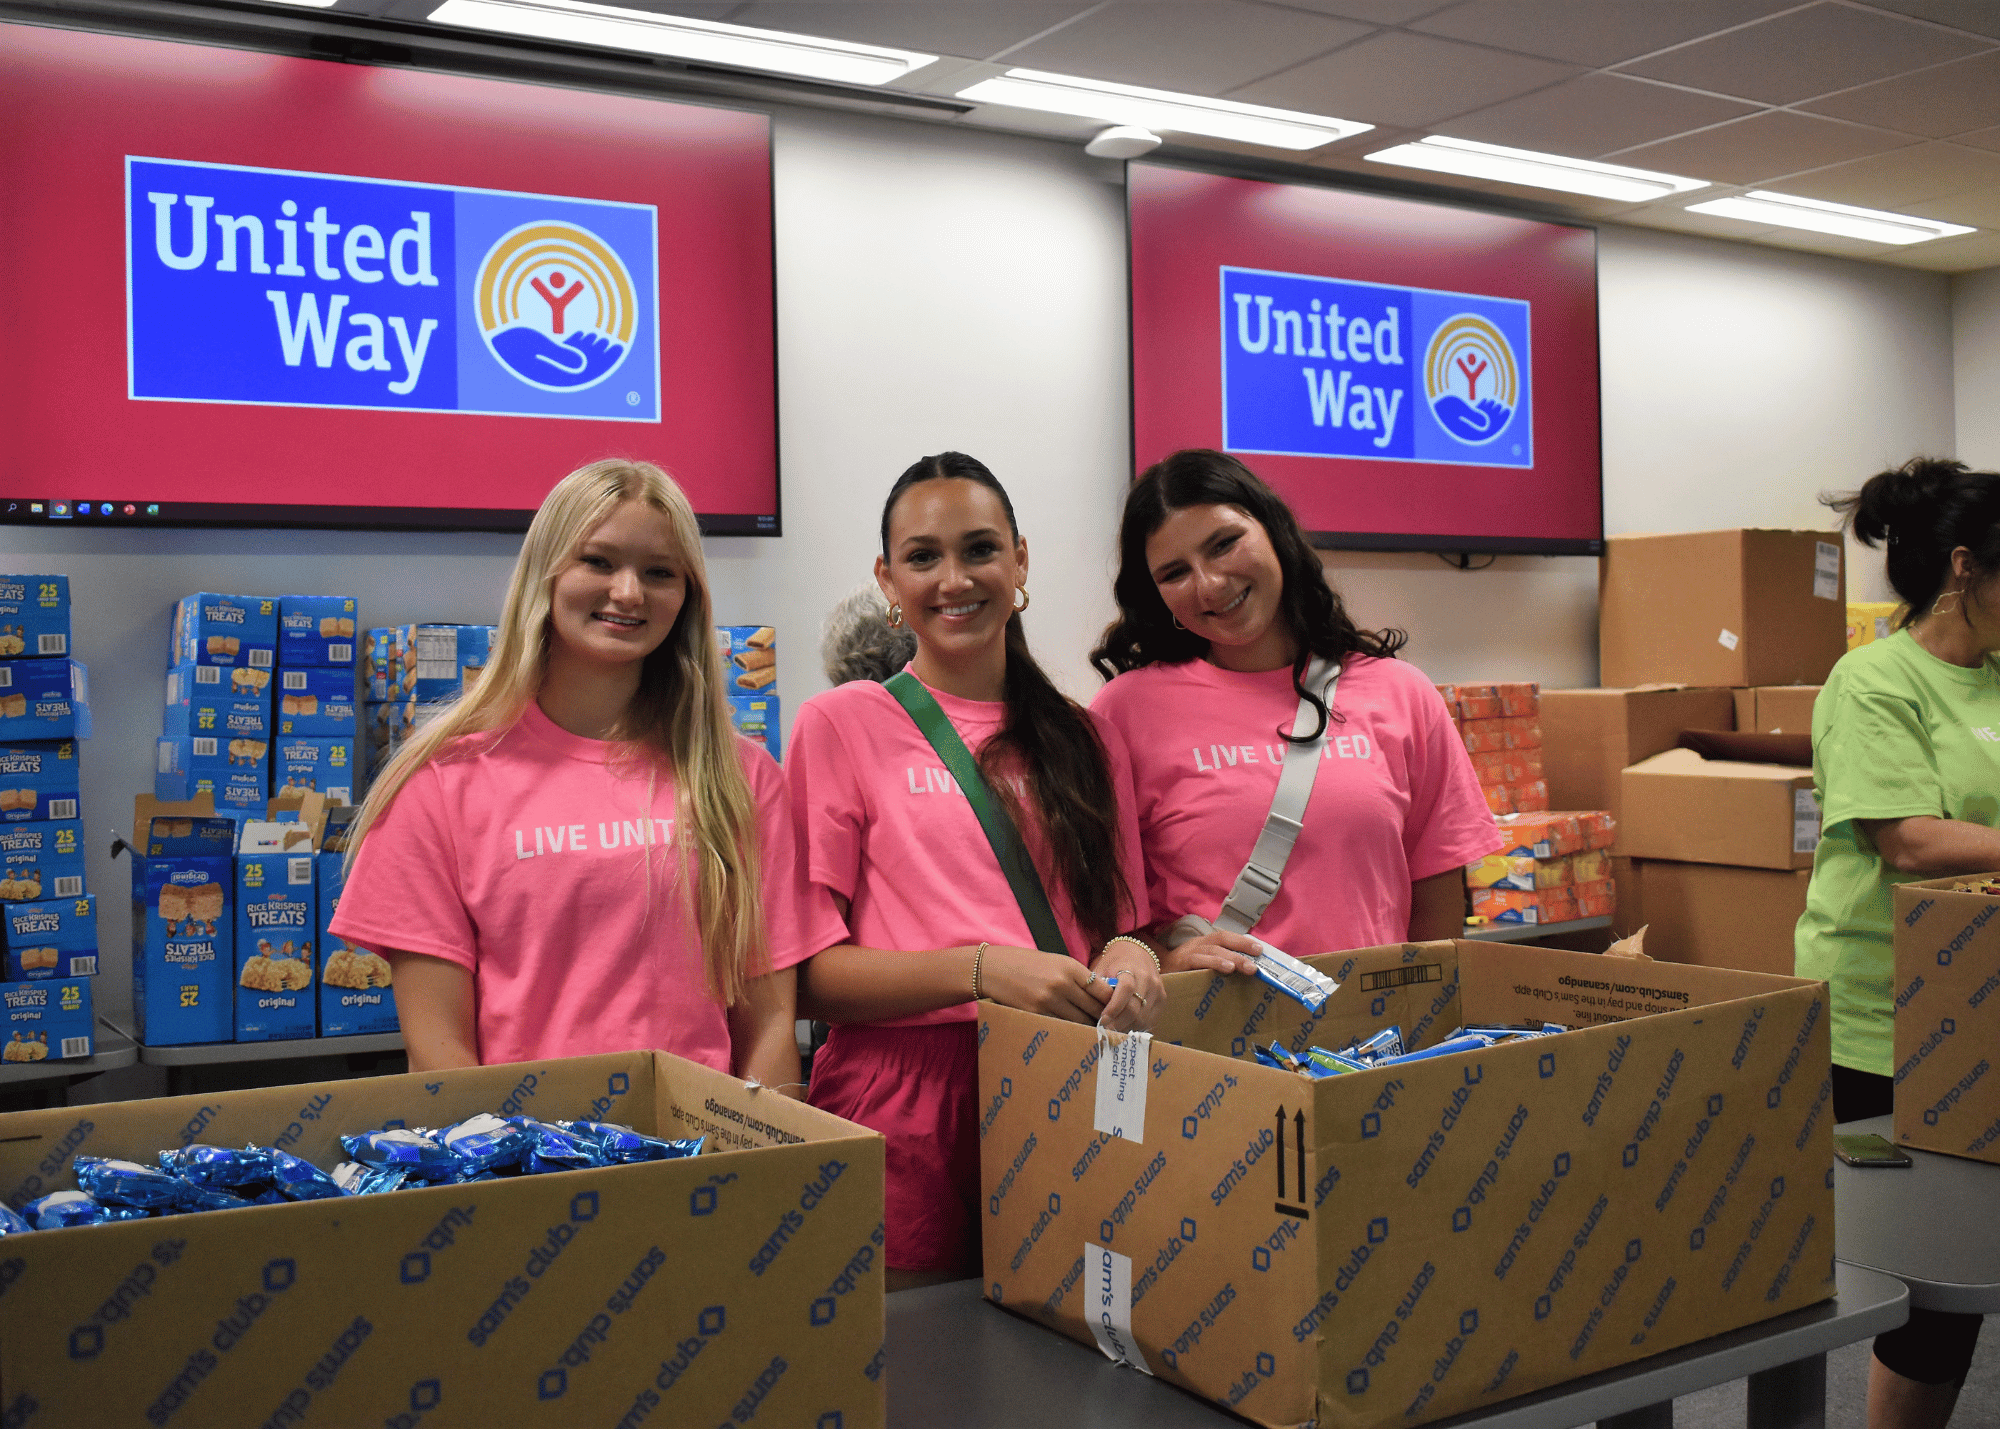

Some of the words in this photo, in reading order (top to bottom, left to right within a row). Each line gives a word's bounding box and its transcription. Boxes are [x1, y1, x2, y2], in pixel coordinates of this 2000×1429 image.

[148, 190, 439, 286] United
[266, 290, 439, 395] Way
[1233, 292, 1403, 365] United
[1302, 367, 1403, 448] Way
[0, 590, 24, 600] EATS
[39, 583, 58, 598] 25
[206, 611, 245, 624] TREATS
[199, 716, 214, 729] 25
[227, 715, 262, 725] TREATS
[285, 751, 318, 761] TREATS
[330, 746, 346, 758] 25
[1192, 744, 1259, 772] LIVE
[1266, 734, 1371, 766] UTED
[288, 765, 314, 773] Original
[225, 787, 259, 796] TREATS
[1, 839, 42, 850] TREATS
[56, 830, 74, 843] 25
[515, 824, 588, 860] LIVE
[6, 855, 37, 864] Original
[245, 863, 263, 877] 25
[172, 872, 208, 882] Original
[12, 916, 28, 925] RICE
[29, 913, 60, 922] KRISPIES
[75, 900, 90, 911] 25
[247, 903, 267, 913] RICE
[268, 901, 307, 911] KRISPIES
[248, 911, 306, 927] TREATS
[14, 920, 60, 934] TREATS
[1949, 925, 1974, 951] club
[165, 954, 199, 963] KRISPIES
[166, 942, 213, 955] TREATS
[199, 953, 215, 961] RICE
[6, 996, 47, 1008] TREATS
[61, 986, 80, 1000] 25
[180, 991, 199, 1007] 25
[258, 997, 296, 1009] Original
[341, 994, 382, 1007] Original
[1195, 976, 1225, 1020] sam's
[1431, 984, 1457, 1015] club
[1513, 984, 1532, 996] app.
[1532, 987, 1553, 1000] Club
[1554, 991, 1580, 1004] Sam's
[1558, 976, 1689, 1003] SamsClub.com/scanandgo
[1581, 994, 1596, 1006] the
[1597, 996, 1606, 1006] in
[1607, 997, 1624, 1009] pay
[1625, 1000, 1643, 1011] and
[1897, 975, 1925, 1007] sam's
[11, 1012, 41, 1021] Original
[1243, 1002, 1267, 1036] club
[1573, 1009, 1592, 1021] line.
[1797, 997, 1822, 1047] sam's
[1291, 1020, 1315, 1053] club
[1732, 1019, 1758, 1070] sam's
[1919, 1031, 1943, 1057] club
[1112, 1046, 1120, 1077] ecial
[1116, 1039, 1129, 1102] omething
[1657, 1048, 1685, 1100] sam's
[1778, 1046, 1799, 1085] club
[1959, 1059, 1990, 1091] sam's
[502, 1074, 538, 1116] club
[1059, 1069, 1082, 1102] club
[1196, 1082, 1226, 1119] club
[1582, 1072, 1613, 1127] sam's
[1935, 1086, 1961, 1112] club
[670, 1104, 685, 1121] app.
[685, 1111, 701, 1132] Club
[985, 1095, 1003, 1126] club
[1636, 1100, 1662, 1141] club
[701, 1119, 720, 1140] Sam's
[720, 1127, 733, 1145] the
[1406, 1129, 1445, 1189] sam's
[1441, 1086, 1468, 1131] club
[1494, 1104, 1529, 1160] sam's
[1013, 1132, 1038, 1173] sam's
[1071, 1139, 1101, 1182] sam's
[1211, 1159, 1247, 1206] sam's
[1245, 1128, 1274, 1165] club
[1655, 1158, 1688, 1213] sam's
[1686, 1118, 1710, 1159] club
[1725, 1132, 1755, 1185] sam's
[997, 1168, 1015, 1198] club
[1134, 1151, 1166, 1195] sam's
[1469, 1159, 1499, 1205] club
[749, 1209, 804, 1277] sam's
[801, 1160, 844, 1211] club
[1112, 1190, 1136, 1225] club
[1574, 1193, 1609, 1249] sam's
[1703, 1185, 1728, 1228] club
[1749, 1200, 1774, 1241] club
[1011, 1237, 1032, 1272] sam's
[1030, 1210, 1051, 1242] club
[1494, 1222, 1530, 1280] sam's
[1528, 1178, 1556, 1223] club
[525, 1223, 575, 1278] club
[1156, 1237, 1182, 1272] club
[832, 1245, 875, 1296] club
[1101, 1250, 1114, 1308] am's
[1549, 1249, 1576, 1293] club
[1601, 1264, 1629, 1306] club
[1200, 1282, 1237, 1327] sam's
[1293, 1291, 1338, 1342] sam's
[1335, 1245, 1370, 1291] club
[1396, 1261, 1435, 1321] sam's
[563, 1313, 611, 1367] club
[1101, 1309, 1127, 1358] club
[1172, 1320, 1202, 1354] club
[1365, 1320, 1399, 1367] club
[656, 1337, 702, 1390] club
